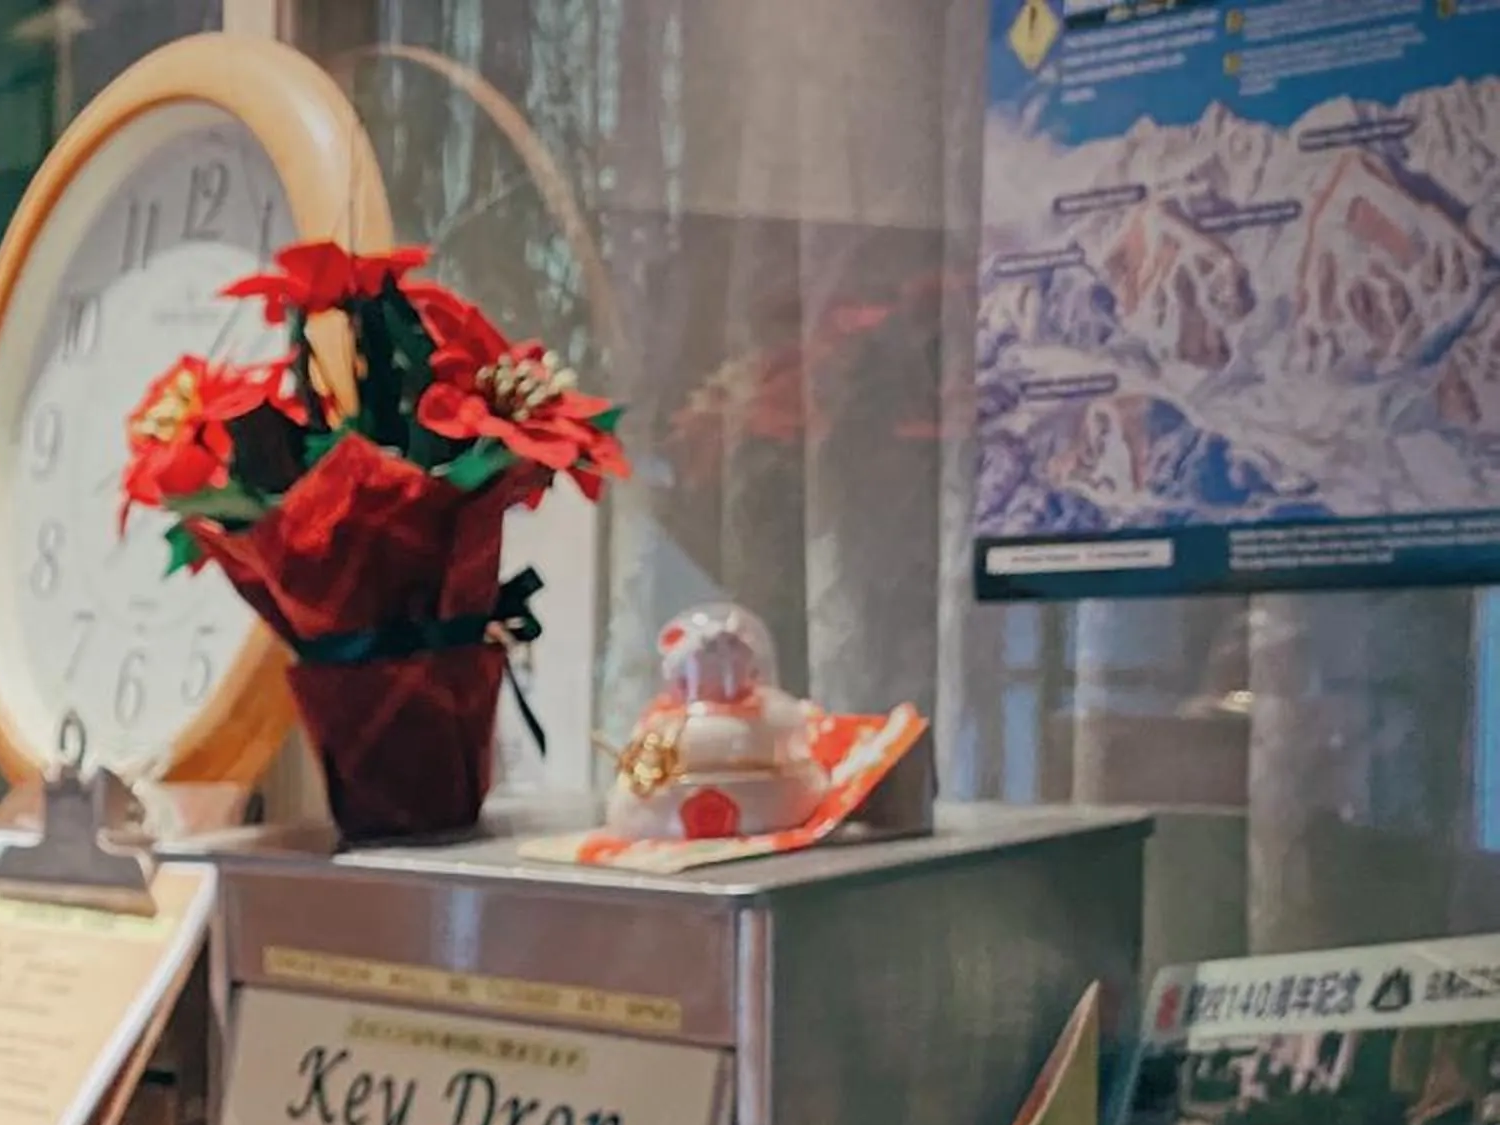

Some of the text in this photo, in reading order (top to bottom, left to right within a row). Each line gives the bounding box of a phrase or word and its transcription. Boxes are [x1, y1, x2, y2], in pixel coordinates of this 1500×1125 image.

[119, 198, 161, 273] 11
[182, 160, 231, 241] 12
[30, 401, 62, 482] 9
[30, 518, 64, 599] 8
[63, 609, 97, 684] 7
[180, 624, 217, 707] 5
[114, 650, 146, 729] 6
